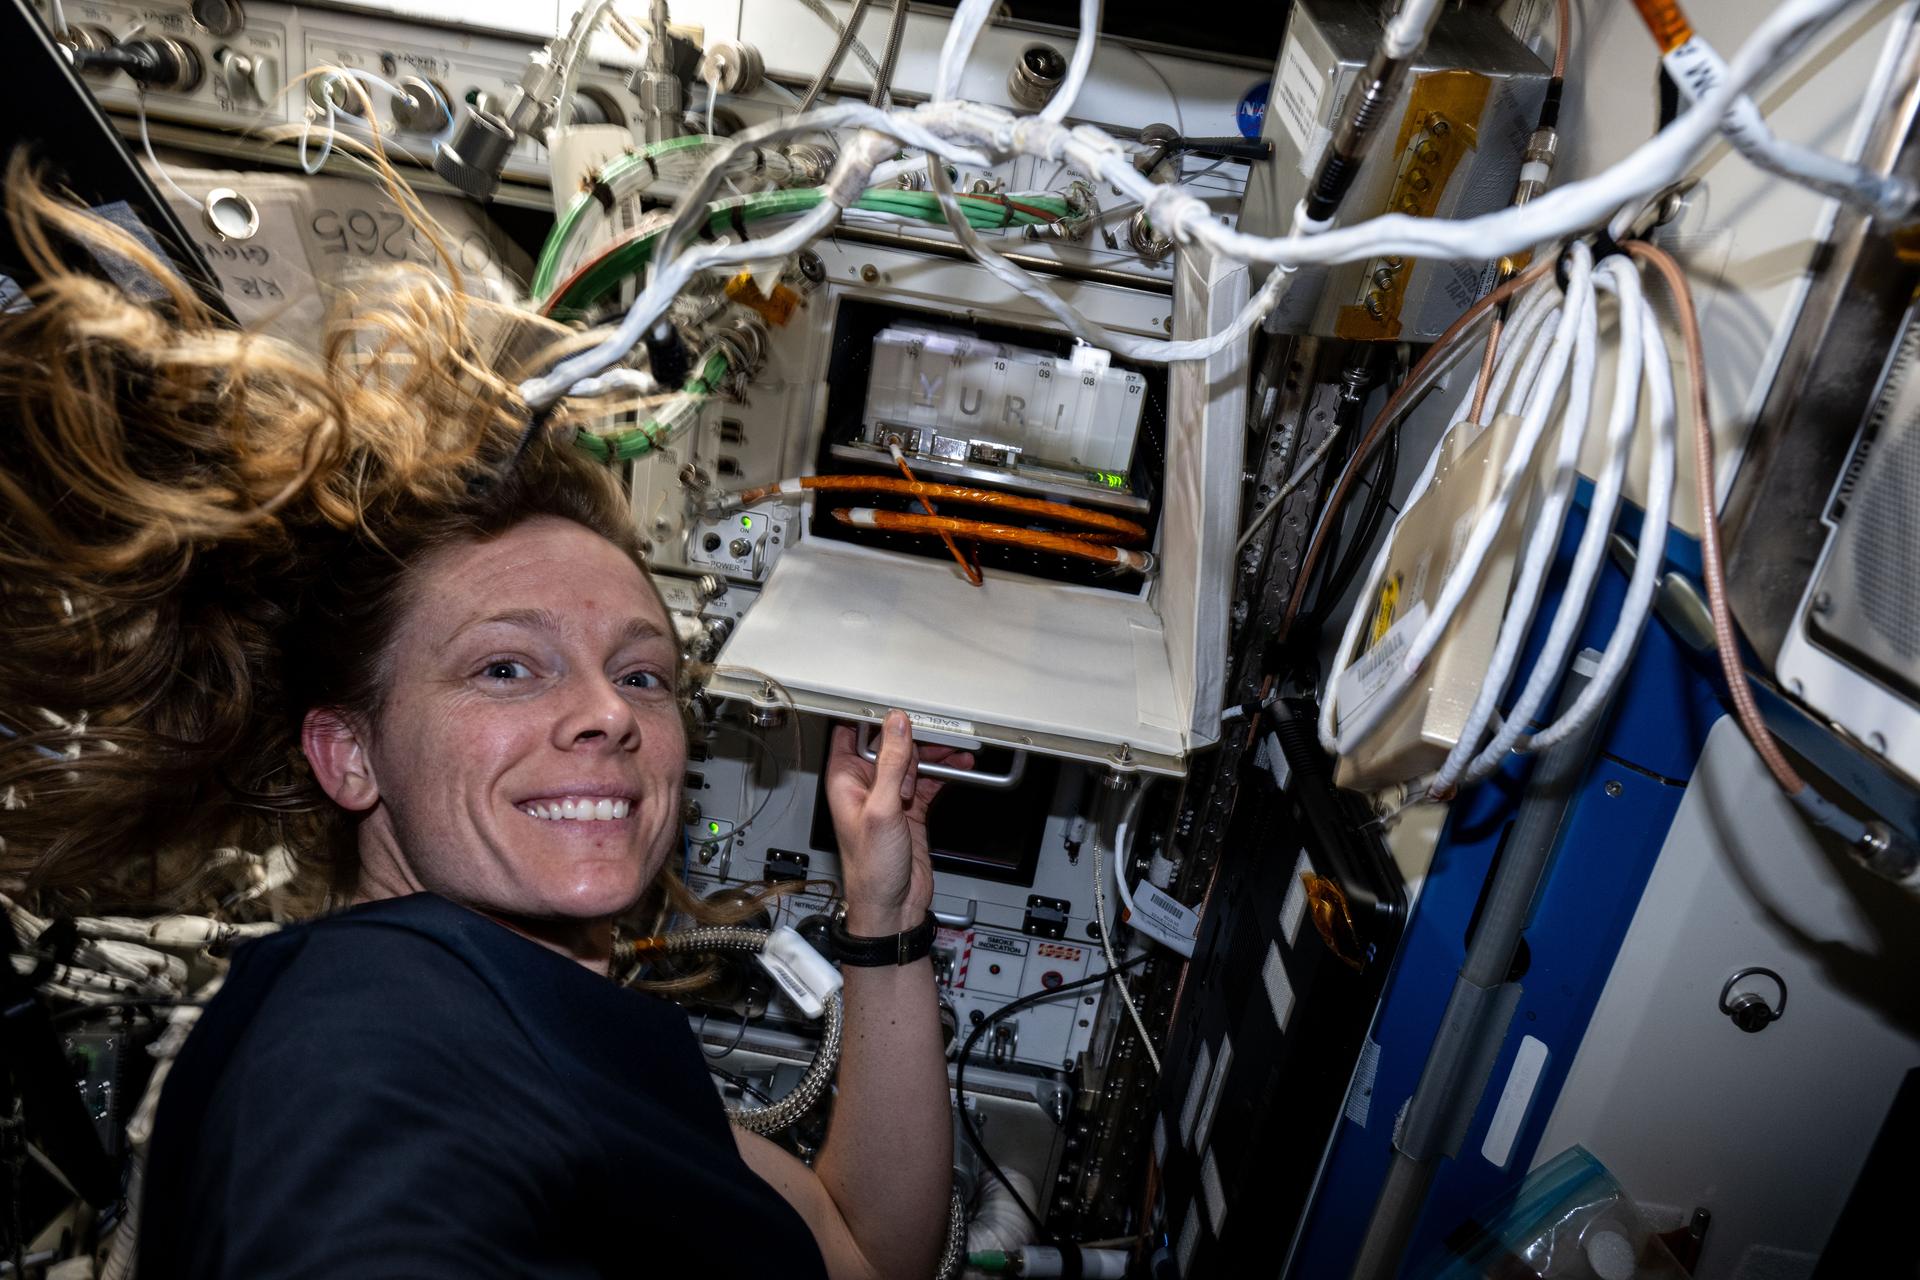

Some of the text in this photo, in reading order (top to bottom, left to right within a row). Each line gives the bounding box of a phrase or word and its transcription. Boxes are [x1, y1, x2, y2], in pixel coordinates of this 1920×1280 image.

[1445, 278, 1471, 308] TAPE
[994, 361, 1005, 371] 10
[1038, 369, 1050, 379] 09
[1083, 376, 1095, 386] 08
[1129, 385, 1141, 394] 07
[710, 560, 740, 572] POWER
[987, 936, 1015, 946] SMOKE
[978, 942, 1021, 954] INDICATION
